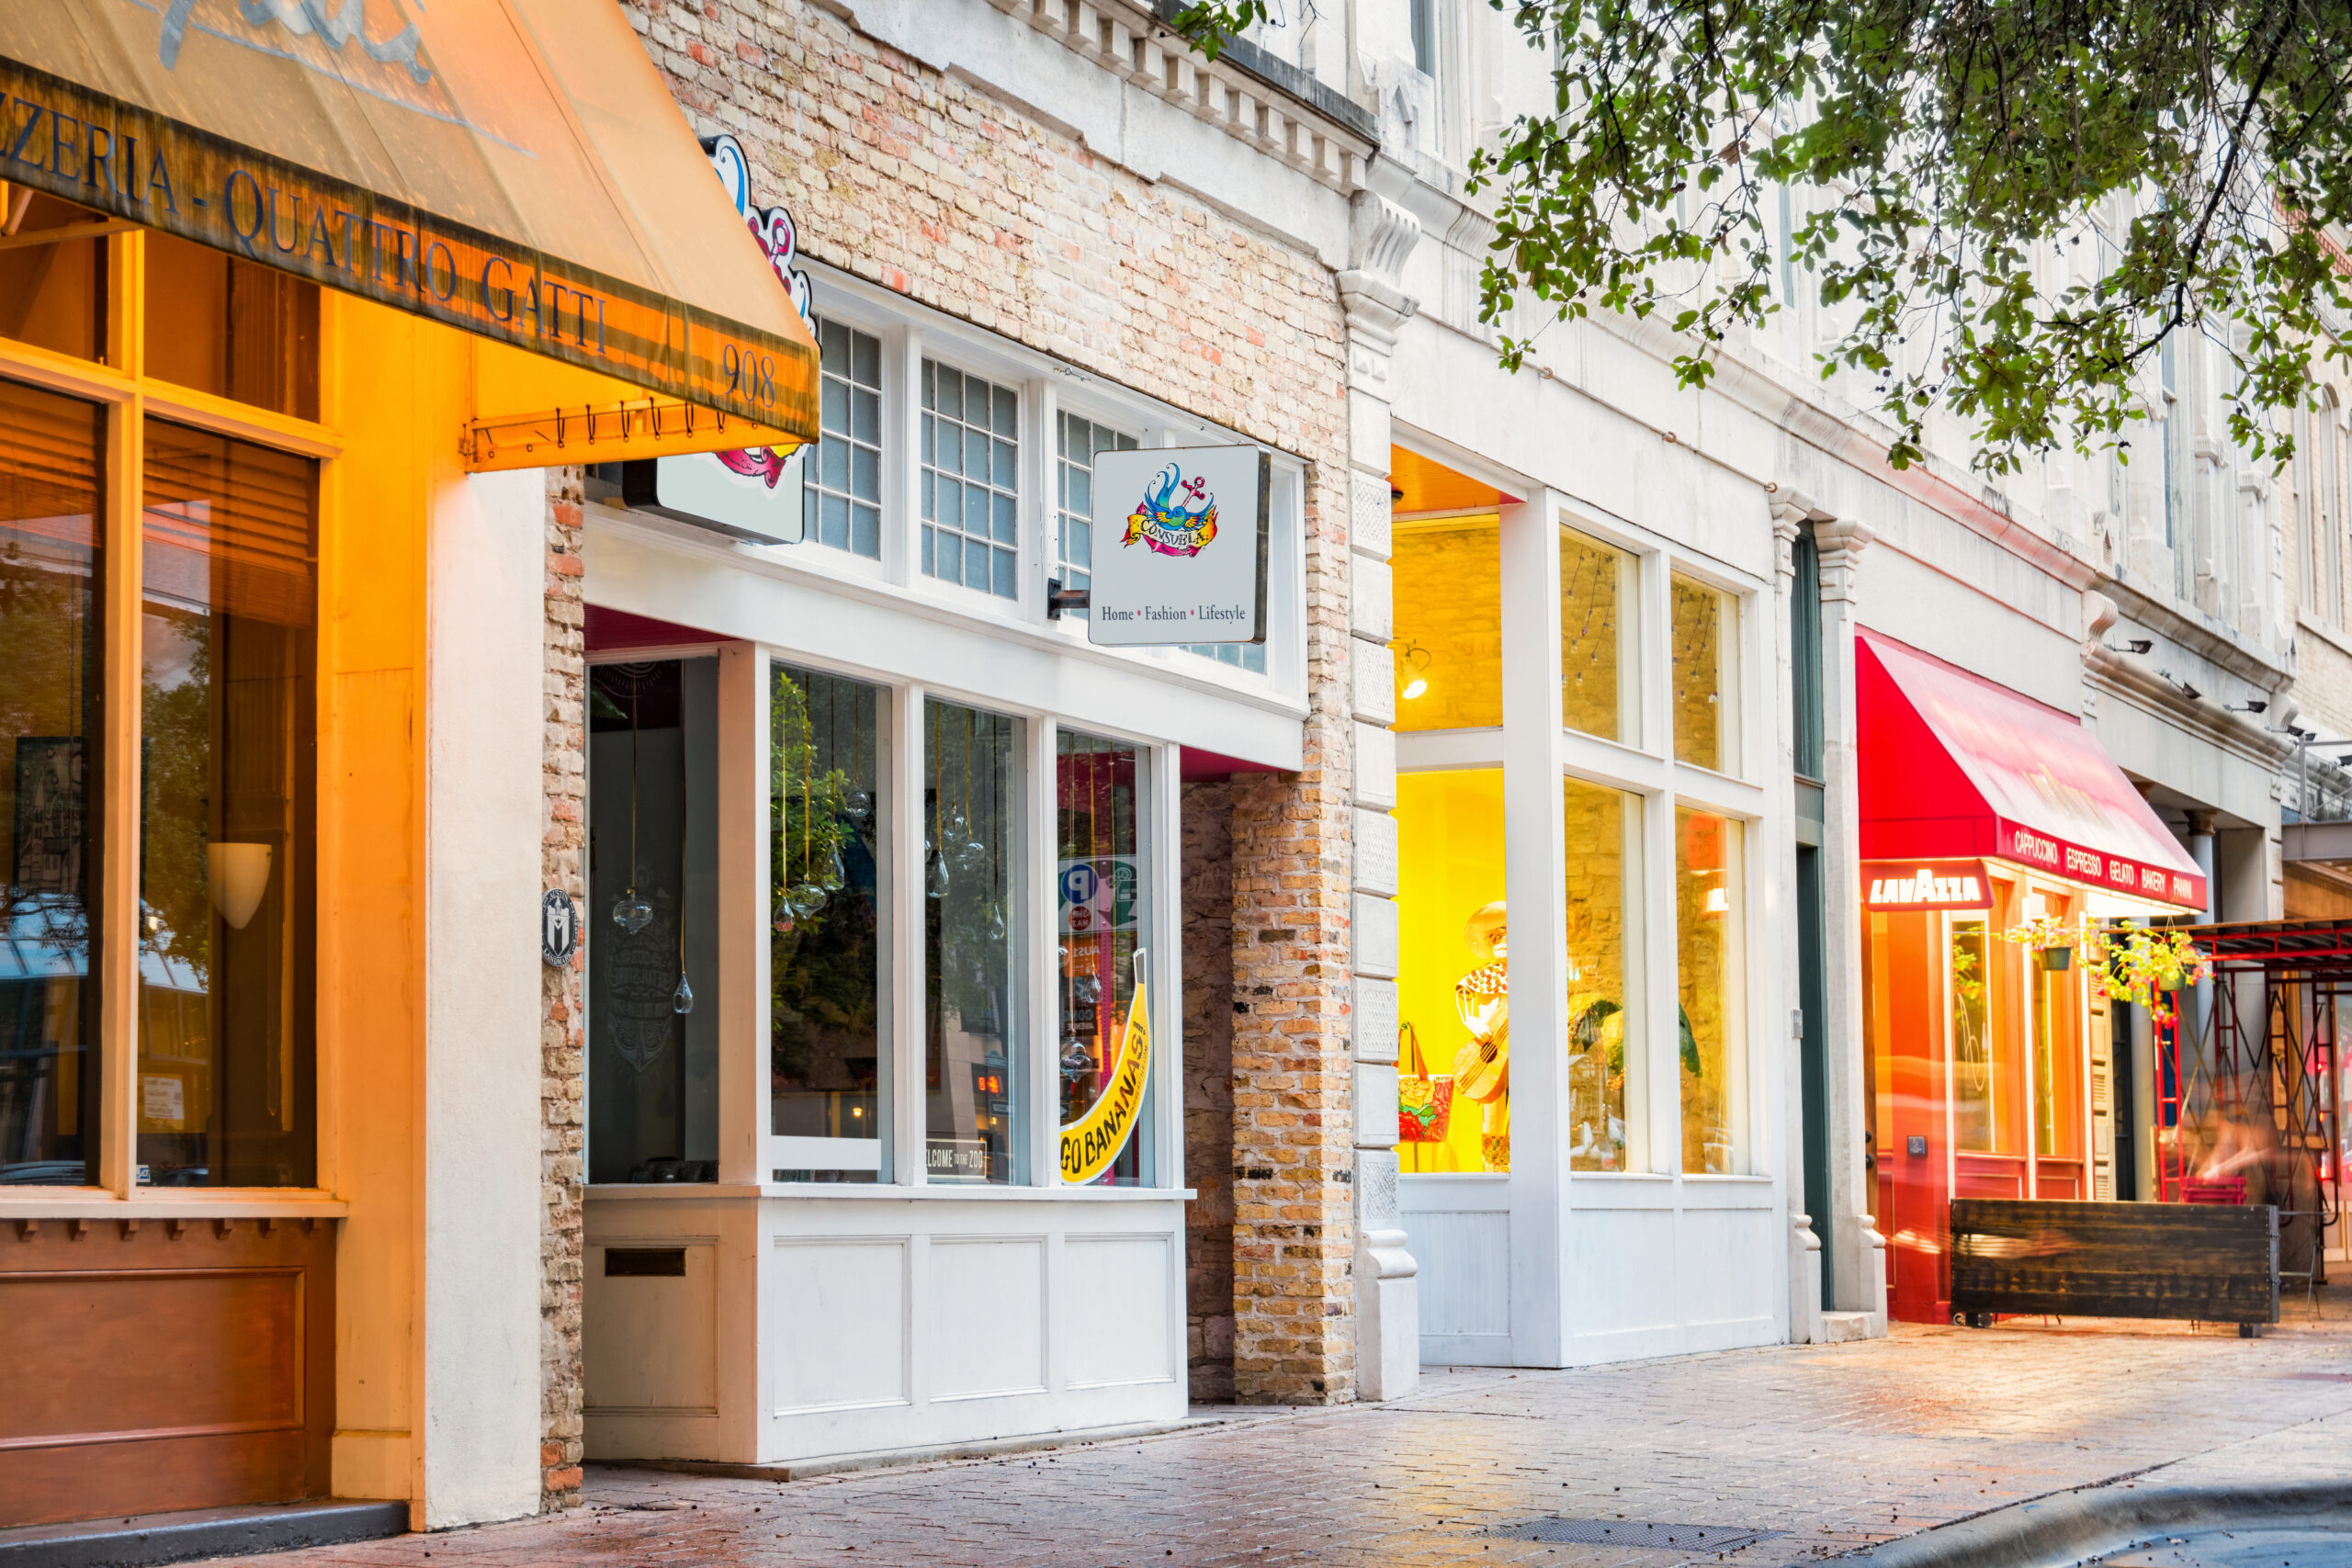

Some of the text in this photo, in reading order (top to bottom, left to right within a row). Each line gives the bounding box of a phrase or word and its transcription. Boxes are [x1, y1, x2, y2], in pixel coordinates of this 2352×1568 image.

[224, 169, 457, 302] QUATTRO
[481, 256, 606, 355] GATTI
[723, 344, 775, 408] 908
[1140, 519, 1205, 547] CONSUELA
[1102, 604, 1246, 625] Home Fashion Lifestyle
[2015, 830, 2192, 900] CAPPUCCINO ESPRESSO GELATO BAKERY PANINI
[549, 888, 569, 902] AUSTIN
[1869, 868, 1982, 904] LAVAZZA
[542, 947, 574, 965] LANDMARK
[926, 1148, 954, 1168] LCOME
[968, 1149, 984, 1168] ZOO
[1060, 1135, 1081, 1175] GO
